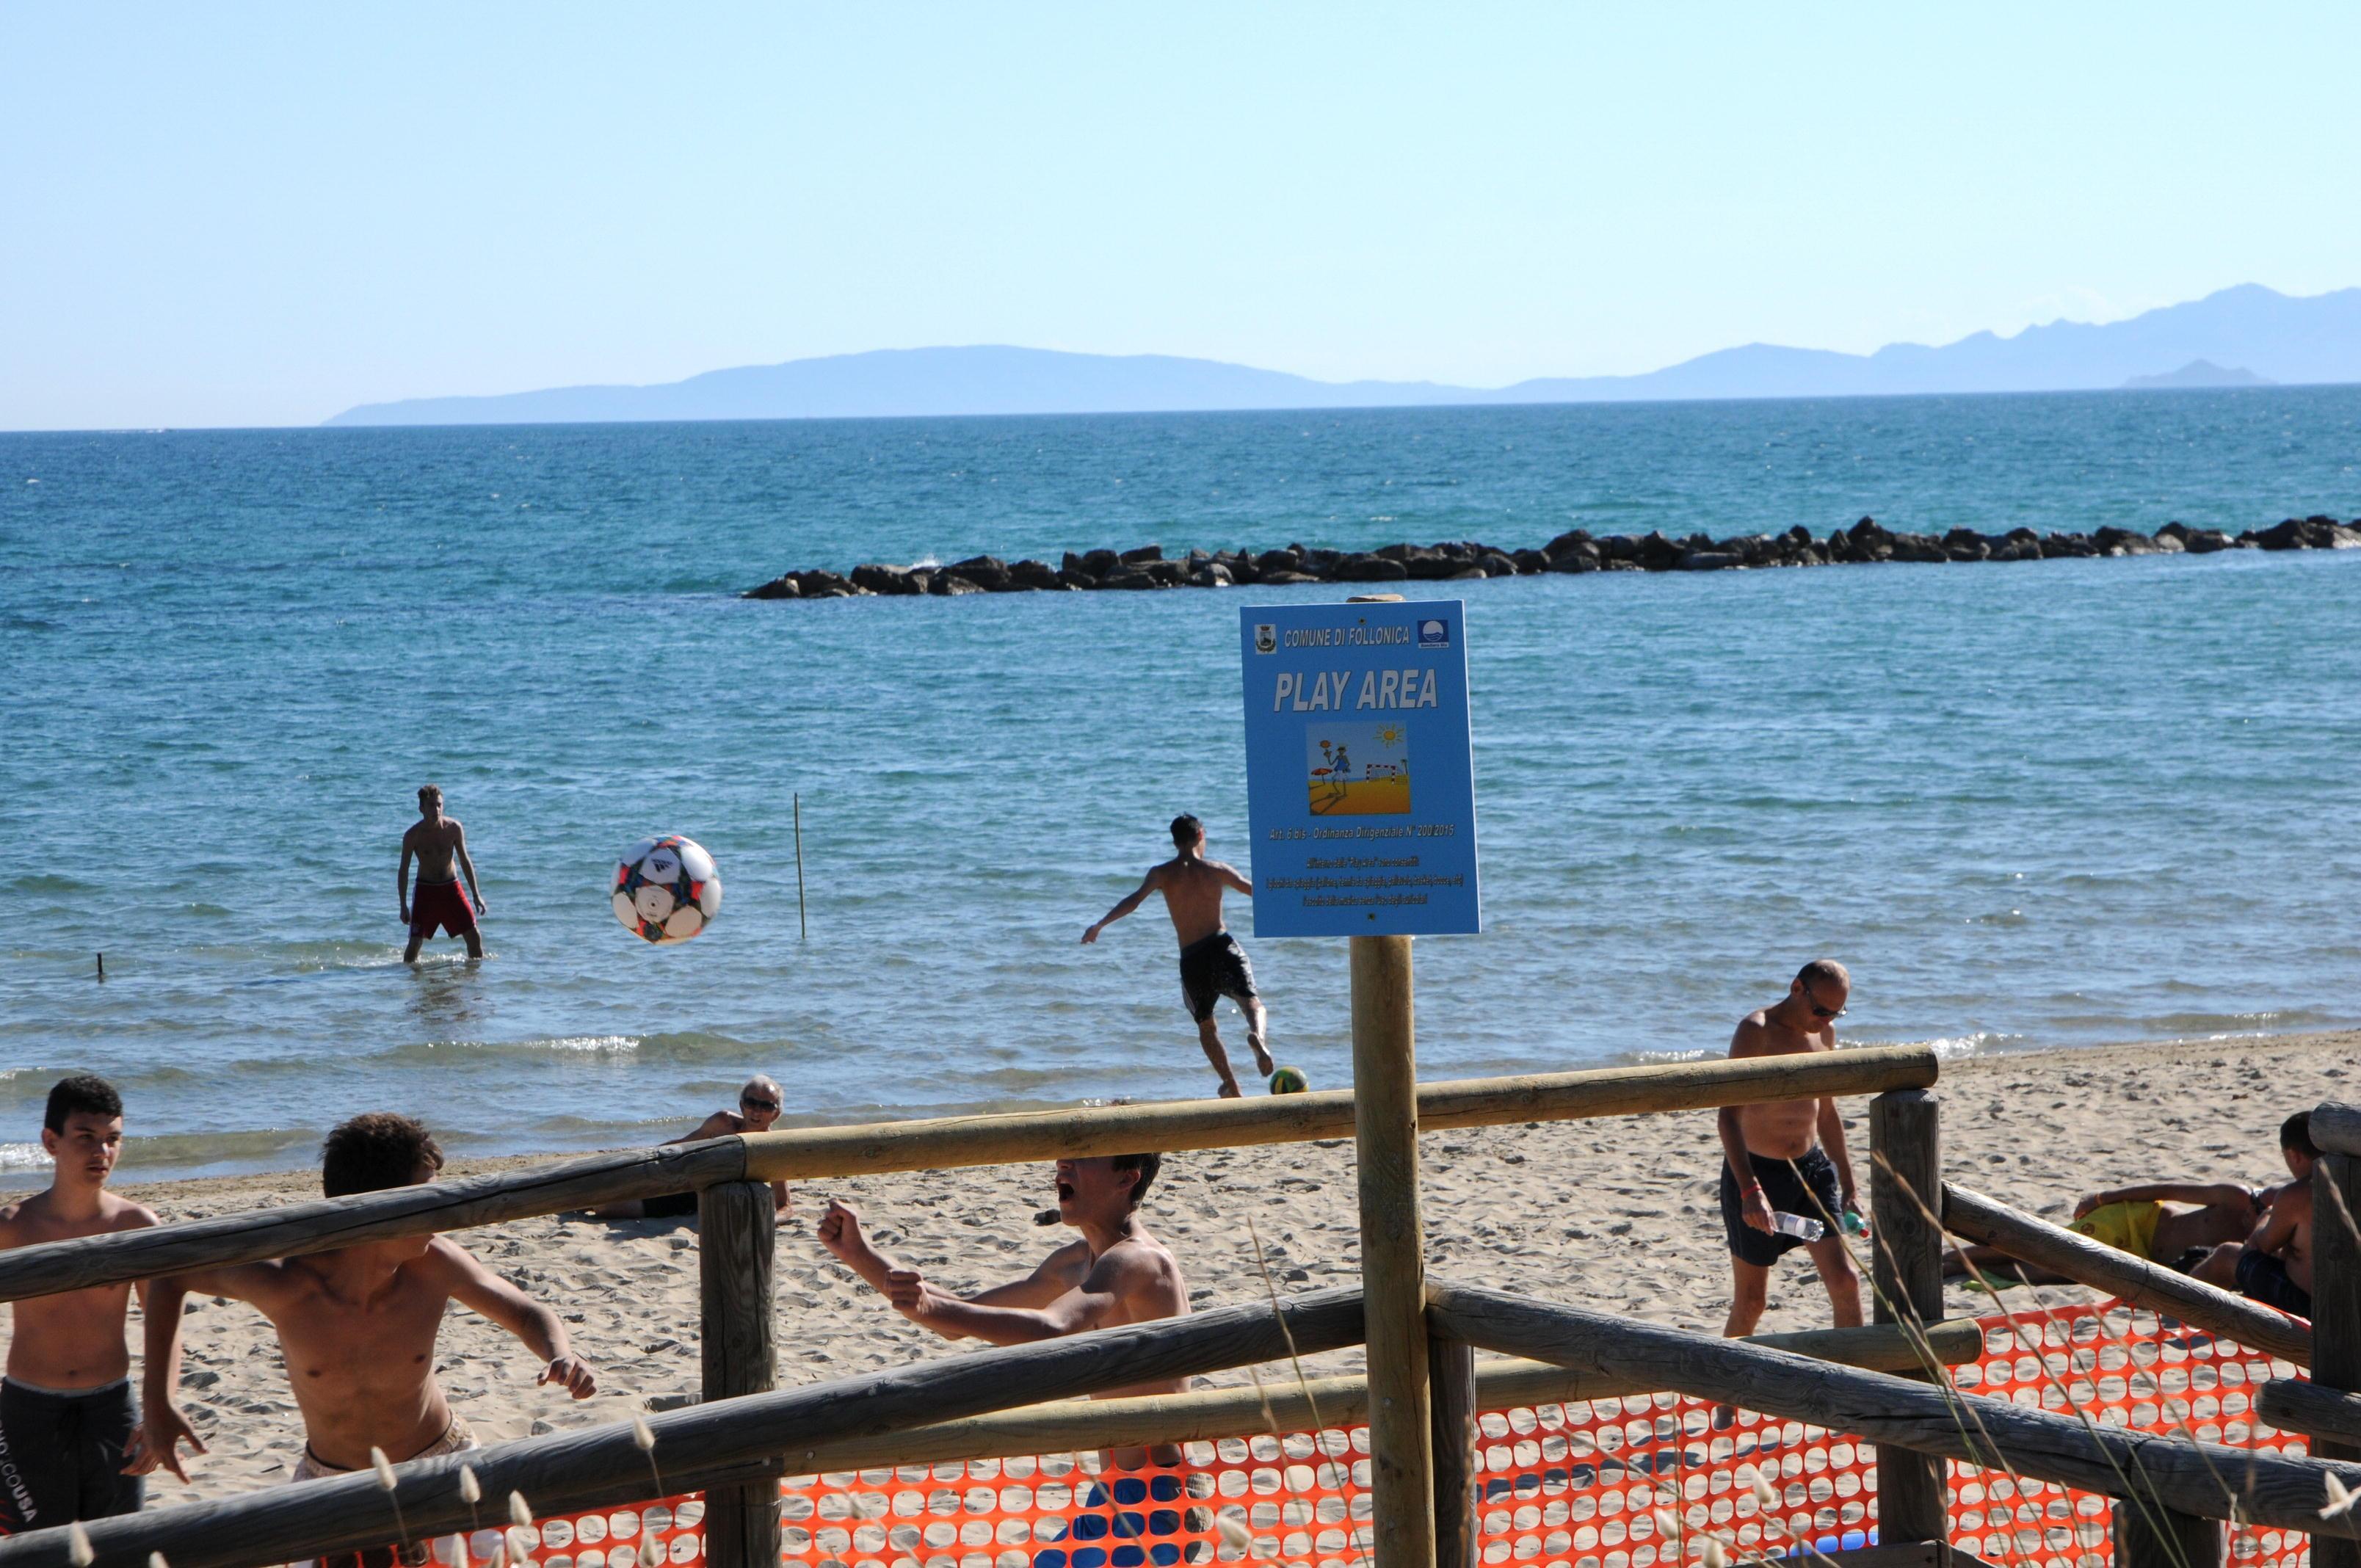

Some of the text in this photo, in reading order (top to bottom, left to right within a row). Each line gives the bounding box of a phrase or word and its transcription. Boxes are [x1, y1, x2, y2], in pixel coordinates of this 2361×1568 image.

[1285, 626, 1410, 648] COMUNE DI FOLLONICA
[1274, 669, 1437, 712] PLAY AREA
[1269, 828, 1285, 840] Art.
[1294, 827, 1306, 839] bis
[1313, 827, 1354, 839] Ordinanza
[1356, 826, 1403, 841] Dirigenziale
